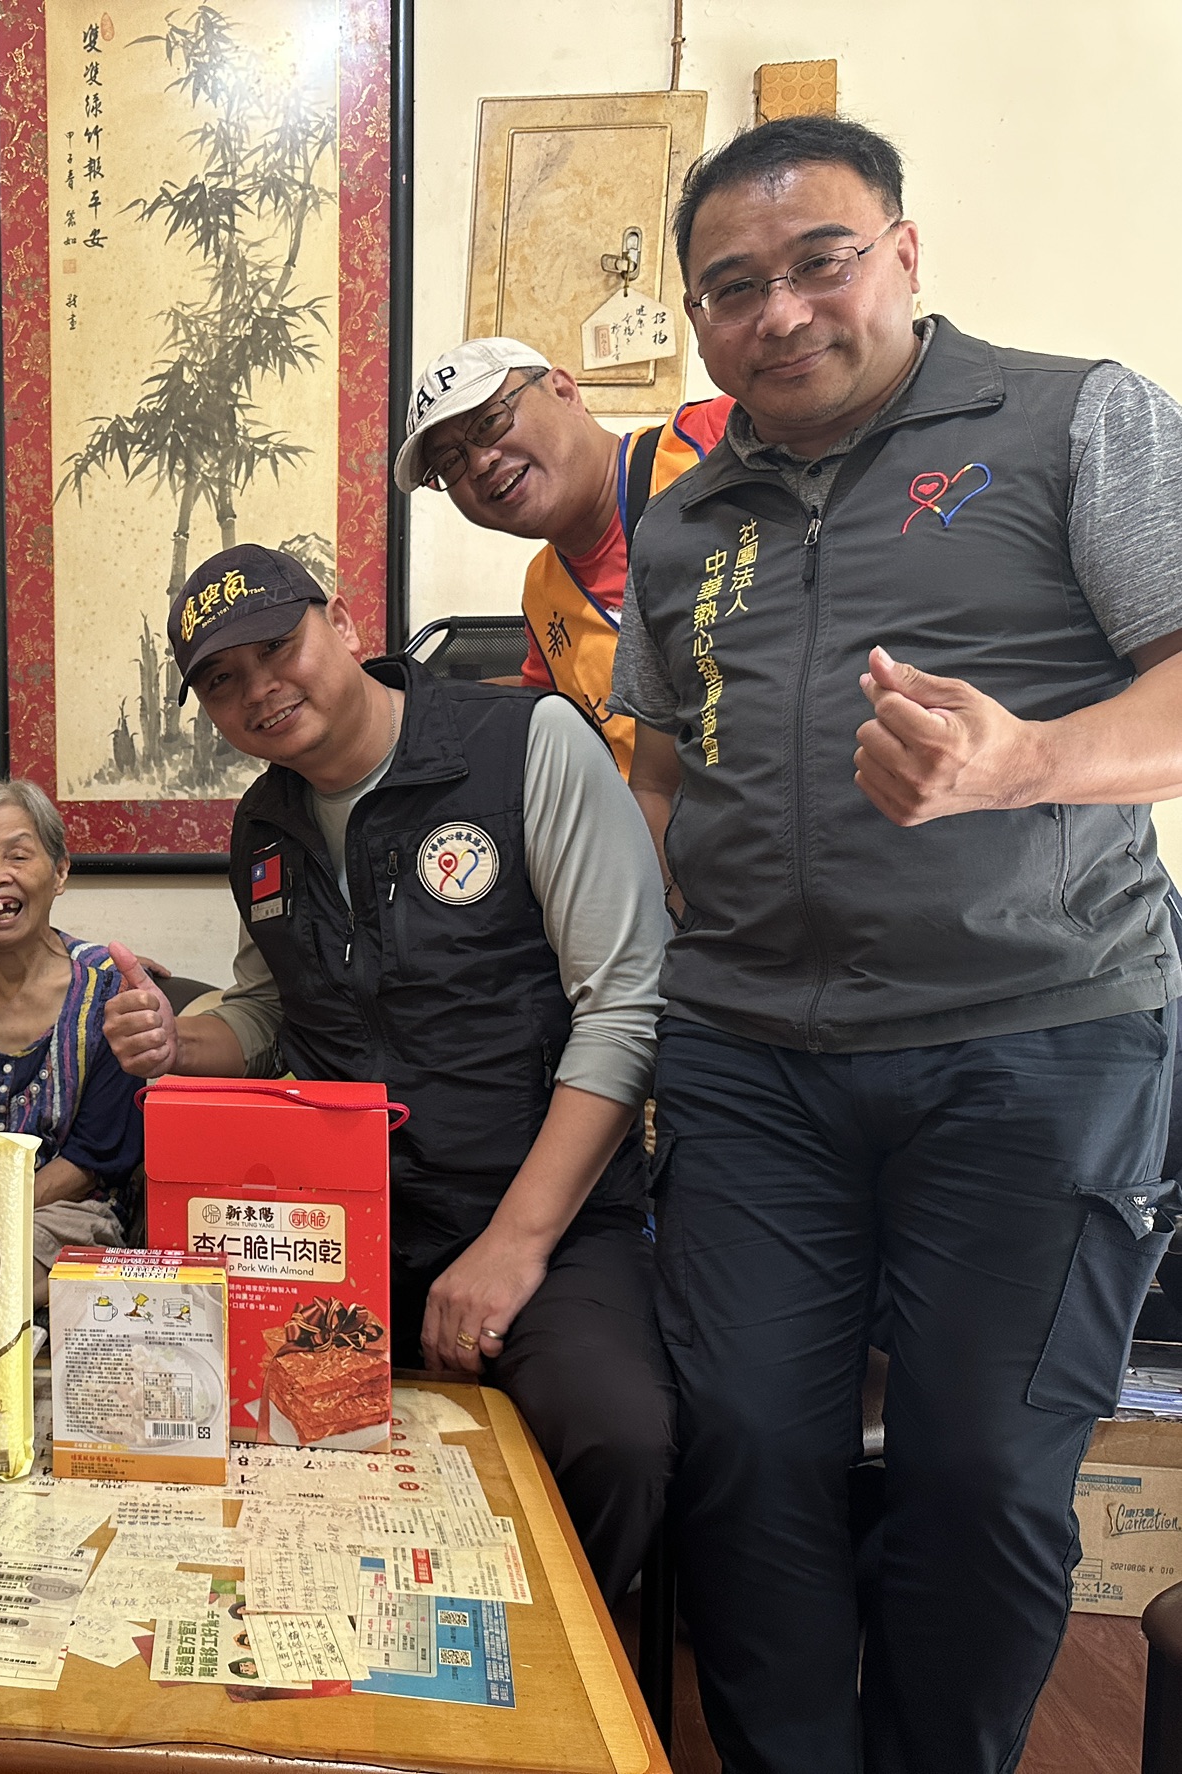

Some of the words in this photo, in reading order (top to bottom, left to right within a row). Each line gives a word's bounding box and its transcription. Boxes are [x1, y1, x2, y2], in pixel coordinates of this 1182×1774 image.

[725, 518, 760, 618] 社團法人
[692, 548, 728, 768] 中華熱心發展協會
[225, 1204, 275, 1223] 新東陽
[192, 1232, 342, 1265] 杏仁脆片肉乾
[237, 1264, 256, 1272] Pork
[257, 1265, 278, 1274] With
[279, 1266, 314, 1276] Almond
[238, 1456, 249, 1467] 8
[303, 1459, 315, 1470] 7
[367, 1462, 379, 1472] 6
[298, 1491, 325, 1499] MON
